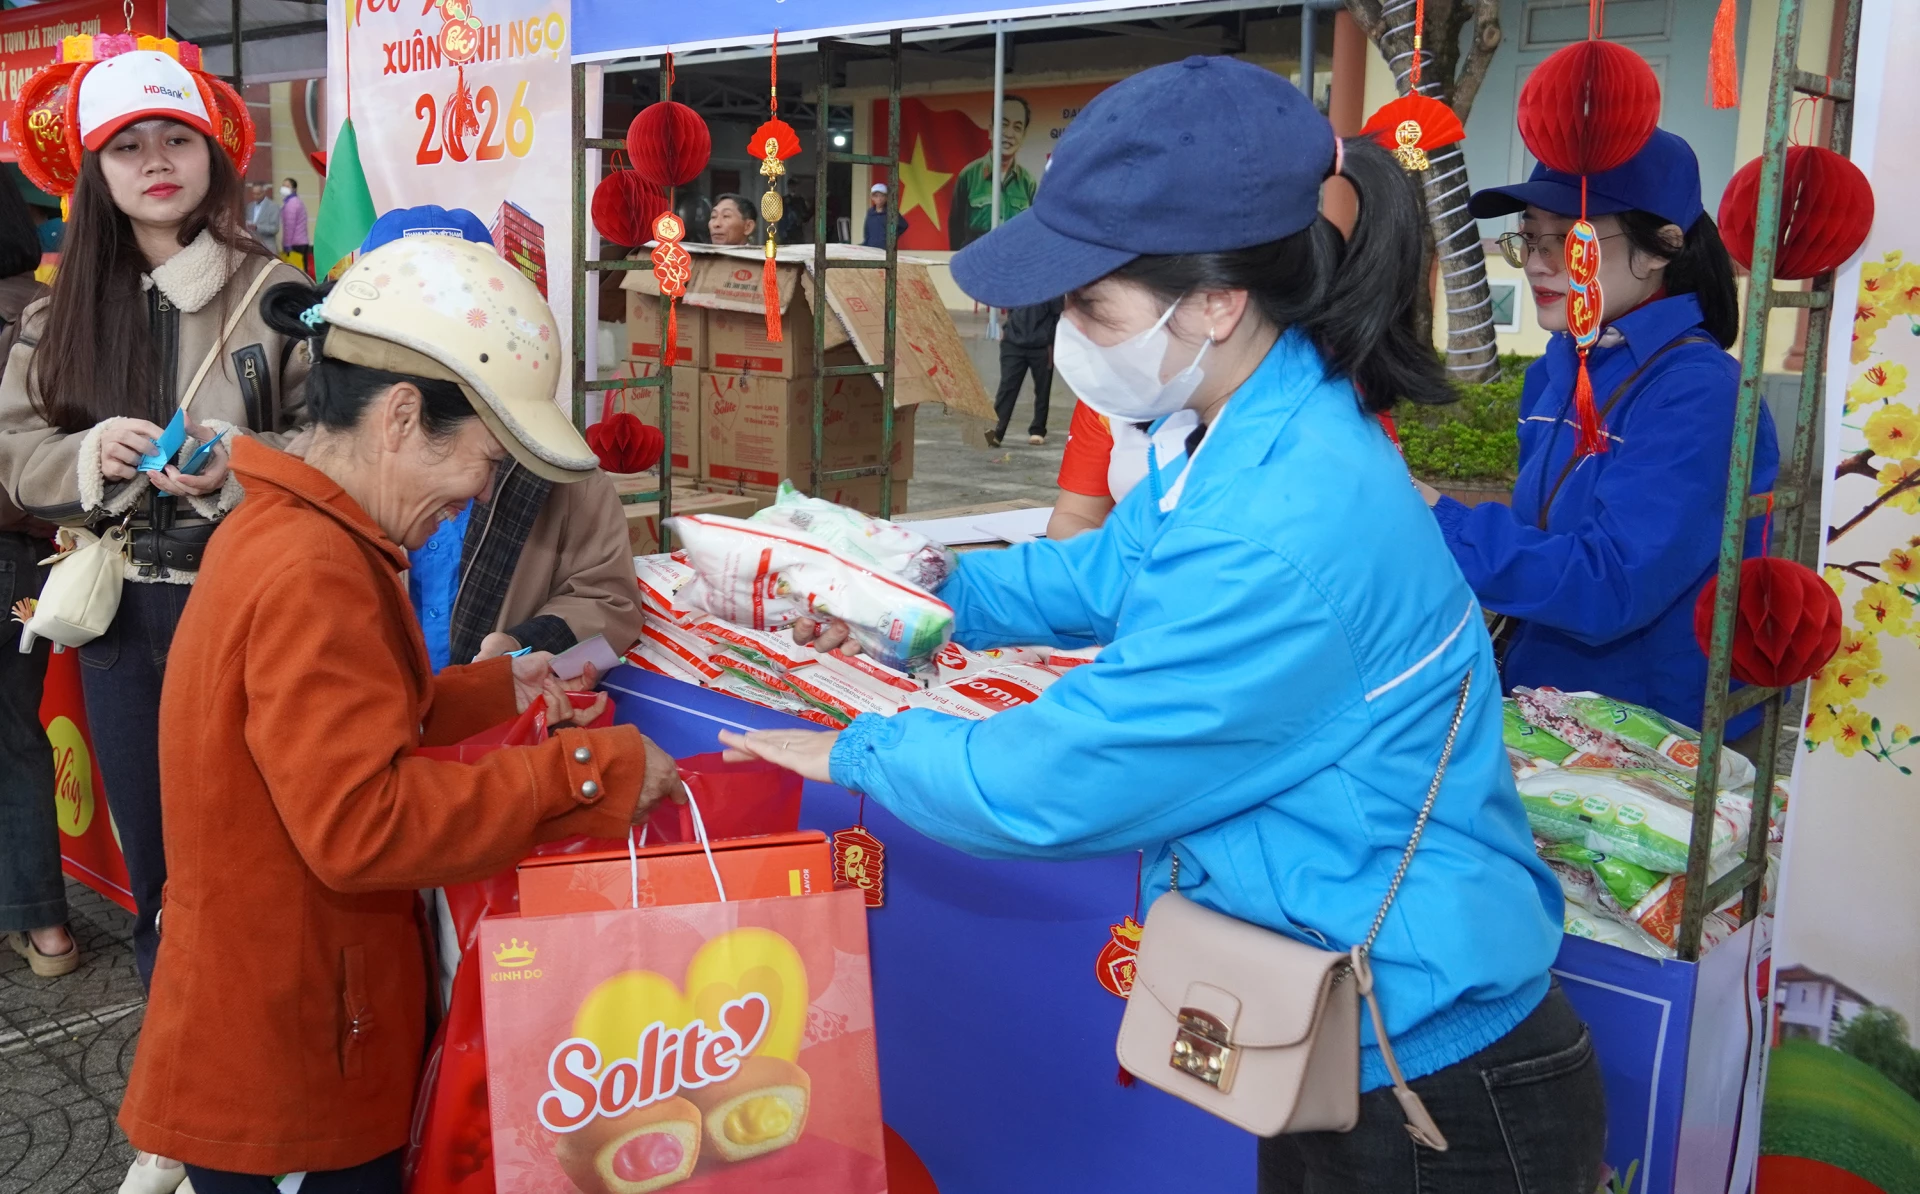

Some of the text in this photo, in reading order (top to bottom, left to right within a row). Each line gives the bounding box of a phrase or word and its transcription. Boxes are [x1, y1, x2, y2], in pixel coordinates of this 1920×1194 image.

[28, 25, 40, 50] XÃ
[383, 29, 441, 75] XUÂN
[508, 12, 566, 60] NGỌ
[144, 85, 183, 100] HDBank
[713, 400, 737, 415] Solite
[967, 680, 1021, 707] iwo
[491, 969, 543, 982] KINH DO
[539, 1021, 740, 1131] Solite
